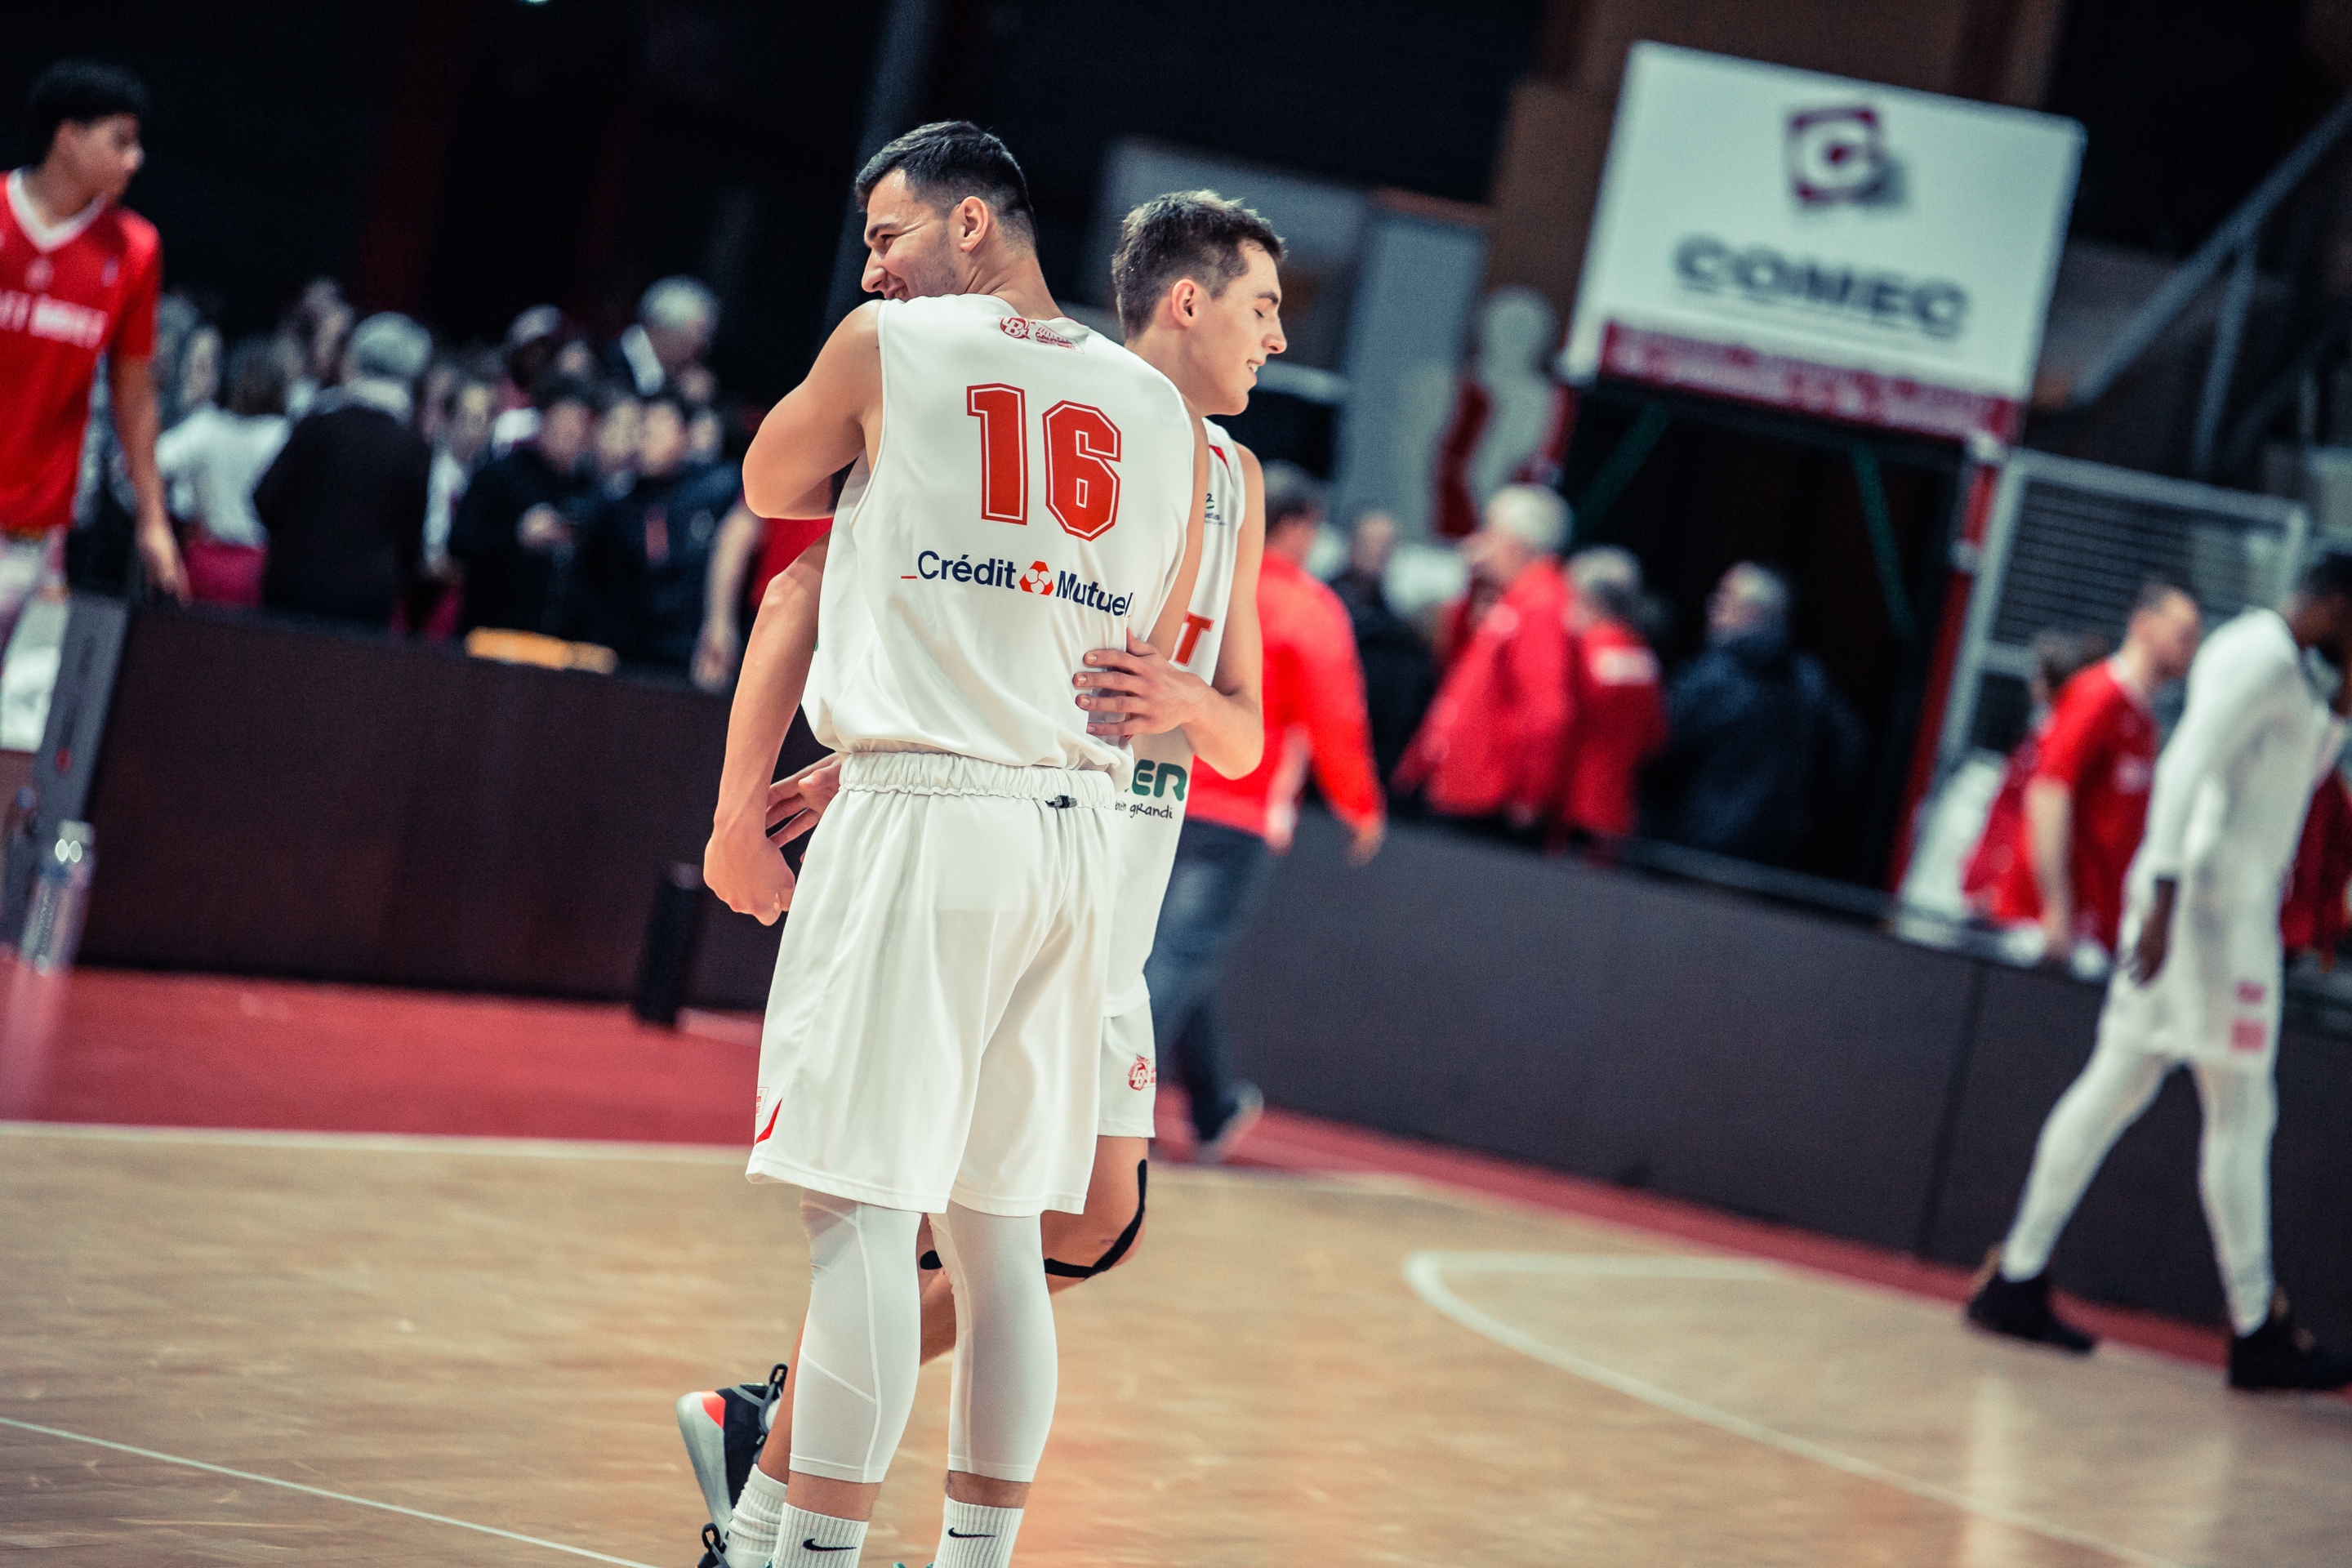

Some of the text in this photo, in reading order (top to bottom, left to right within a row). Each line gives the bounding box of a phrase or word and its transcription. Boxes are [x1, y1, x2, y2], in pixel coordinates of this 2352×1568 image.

[967, 383, 1121, 542] 16
[917, 550, 1134, 617] Crédit Mutuel
[1125, 759, 1187, 801] ER
